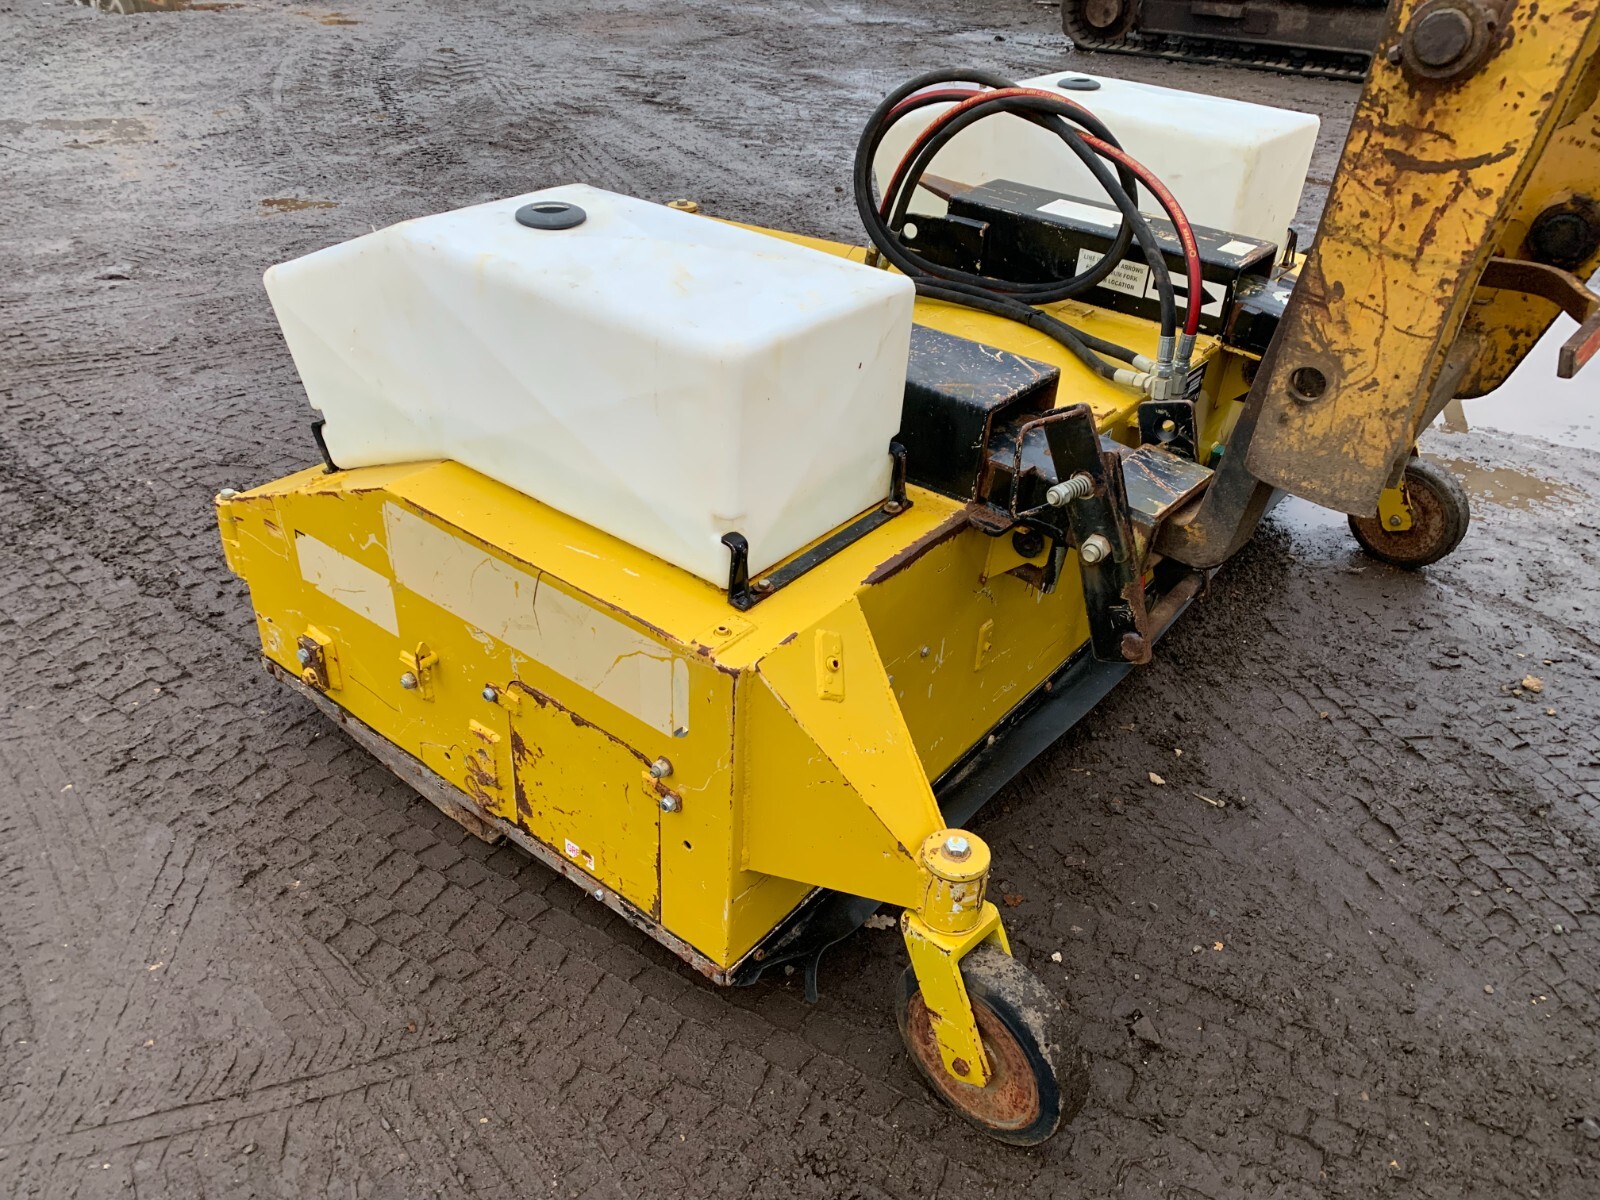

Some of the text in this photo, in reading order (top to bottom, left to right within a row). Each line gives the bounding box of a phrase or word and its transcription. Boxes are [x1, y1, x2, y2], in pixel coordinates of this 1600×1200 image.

[1121, 263, 1144, 275] ARROWS
[1122, 273, 1138, 282] FORK
[1108, 279, 1135, 290] LOCATION
